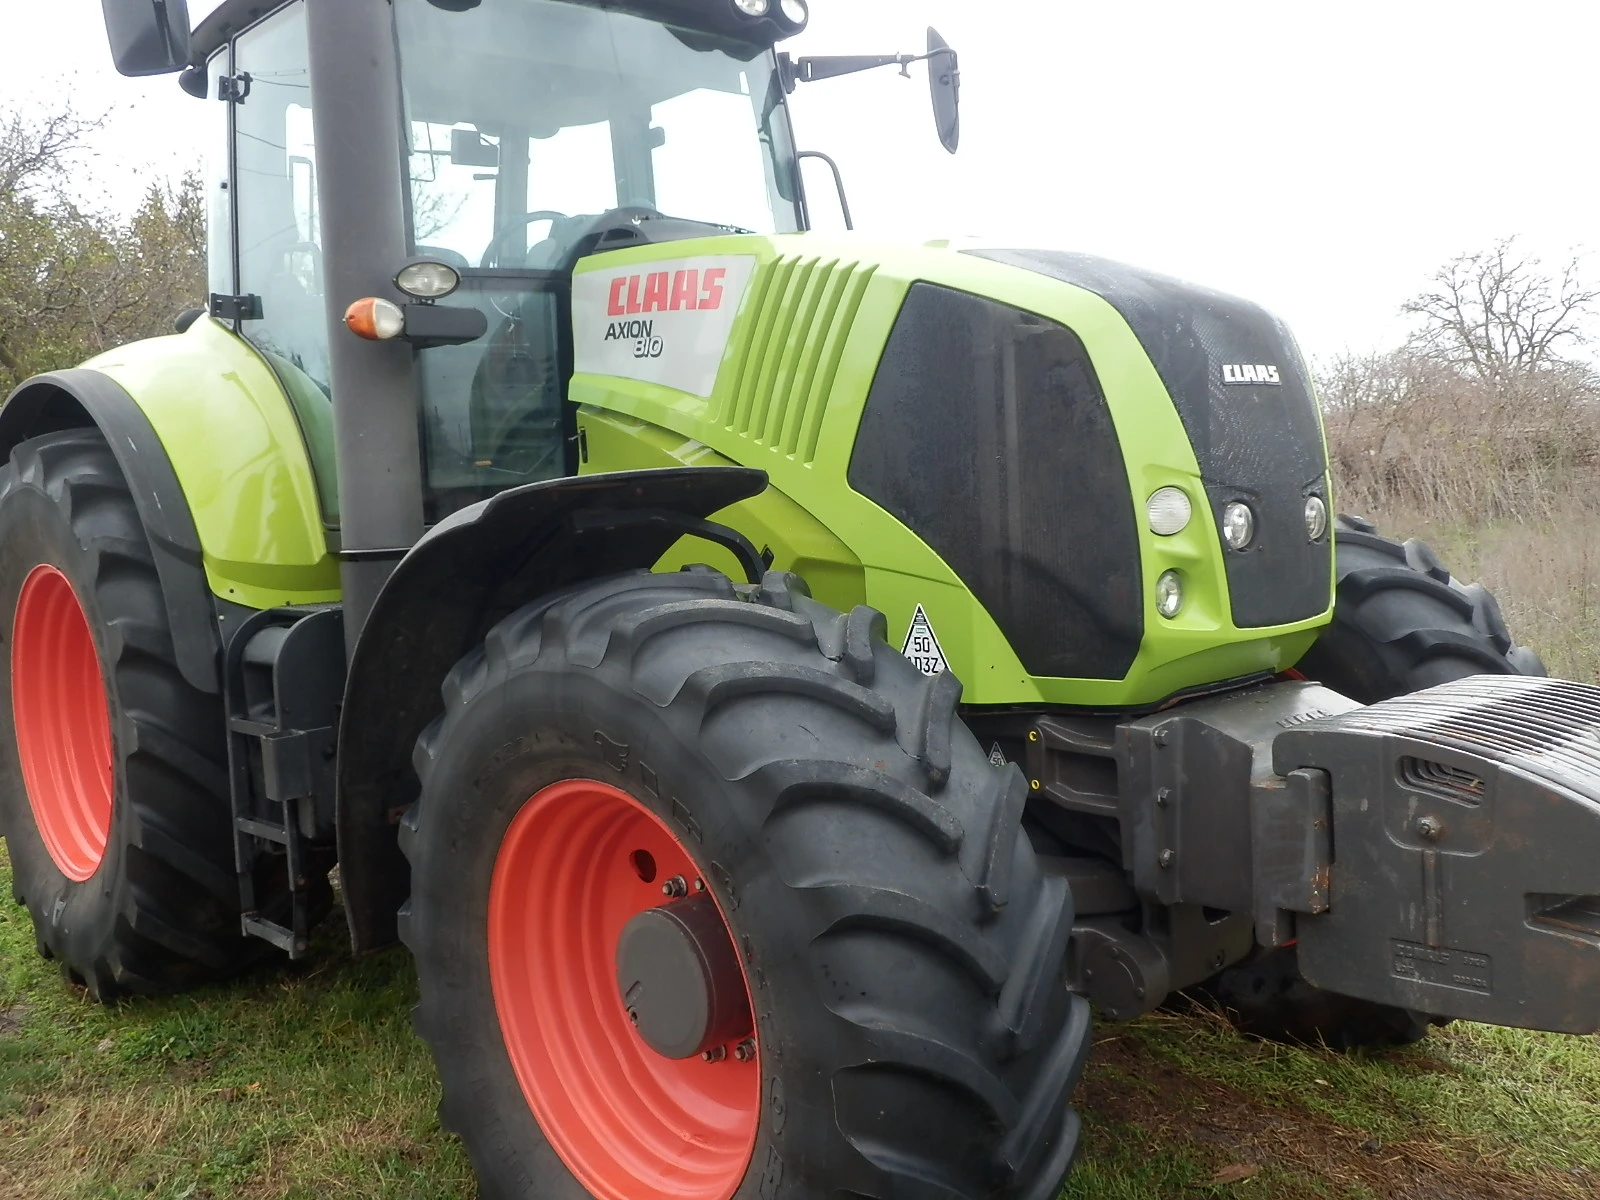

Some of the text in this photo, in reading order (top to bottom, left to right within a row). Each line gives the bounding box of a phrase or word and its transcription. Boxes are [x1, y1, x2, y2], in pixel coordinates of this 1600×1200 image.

[607, 267, 726, 317] CLAAS
[604, 319, 653, 341] AXION
[633, 335, 664, 358] 810
[1222, 364, 1281, 385] CLAAS
[913, 636, 931, 653] 50
[907, 656, 939, 673] D3Z
